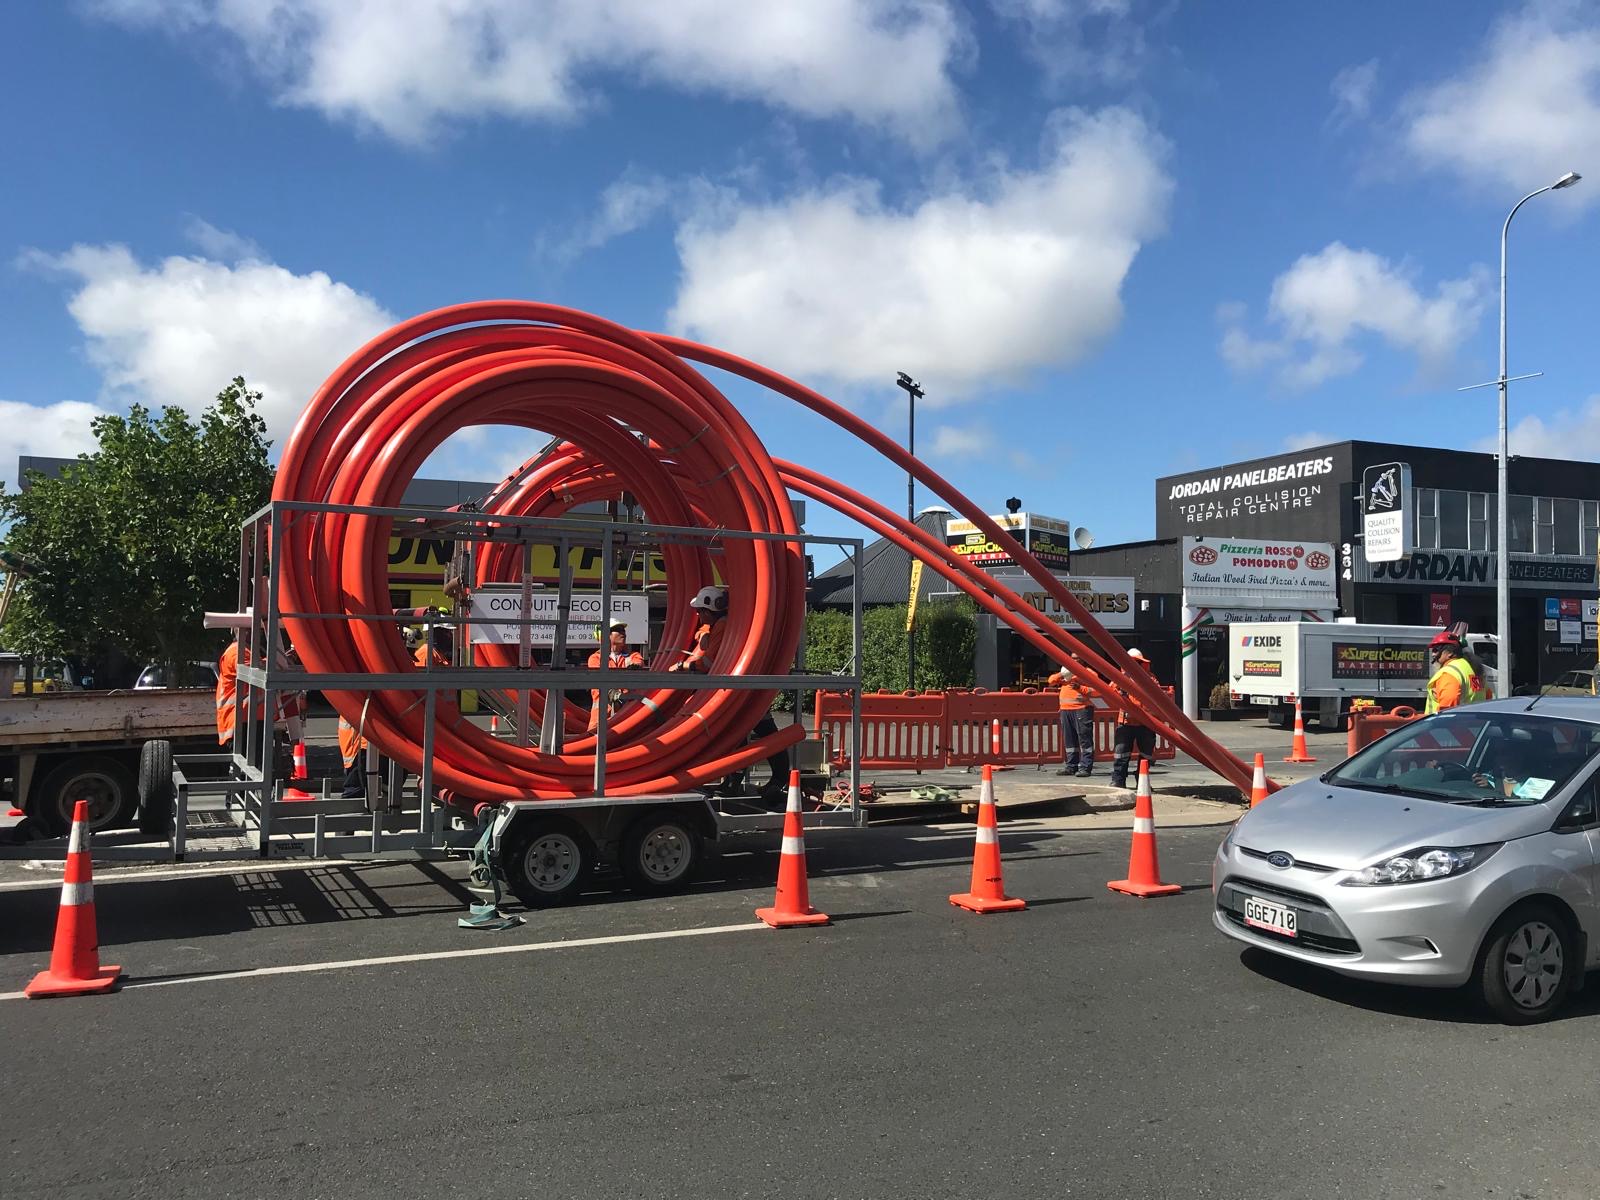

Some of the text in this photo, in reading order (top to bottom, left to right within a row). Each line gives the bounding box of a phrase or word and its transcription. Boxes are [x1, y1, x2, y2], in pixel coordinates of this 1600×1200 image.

[1169, 456, 1333, 500] JORDAN PANELBEATERS
[1180, 484, 1321, 515] TOTAL COLLISION
[1187, 496, 1312, 523] REPAIR CENTRE
[1368, 517, 1395, 528] QUALITY
[1368, 527, 1400, 537] COLLISION
[1368, 538, 1391, 546] REPAIRS
[1220, 543, 1263, 555] Pizzeria
[1373, 552, 1589, 582] JORDAN ANELBEATERS
[1191, 572, 1221, 583] Italian
[1222, 574, 1246, 584] Wood
[1247, 575, 1268, 585] Fired
[1269, 576, 1298, 587] Pizza's
[1300, 577, 1307, 586] &
[490, 598, 556, 611] CONUIT
[1224, 611, 1241, 622] Dine
[1244, 613, 1252, 621] in
[1259, 613, 1278, 622] take
[1254, 636, 1281, 647] EXIDE
[1338, 661, 1423, 669] BATTERIES
[1246, 902, 1295, 930] GGE710
